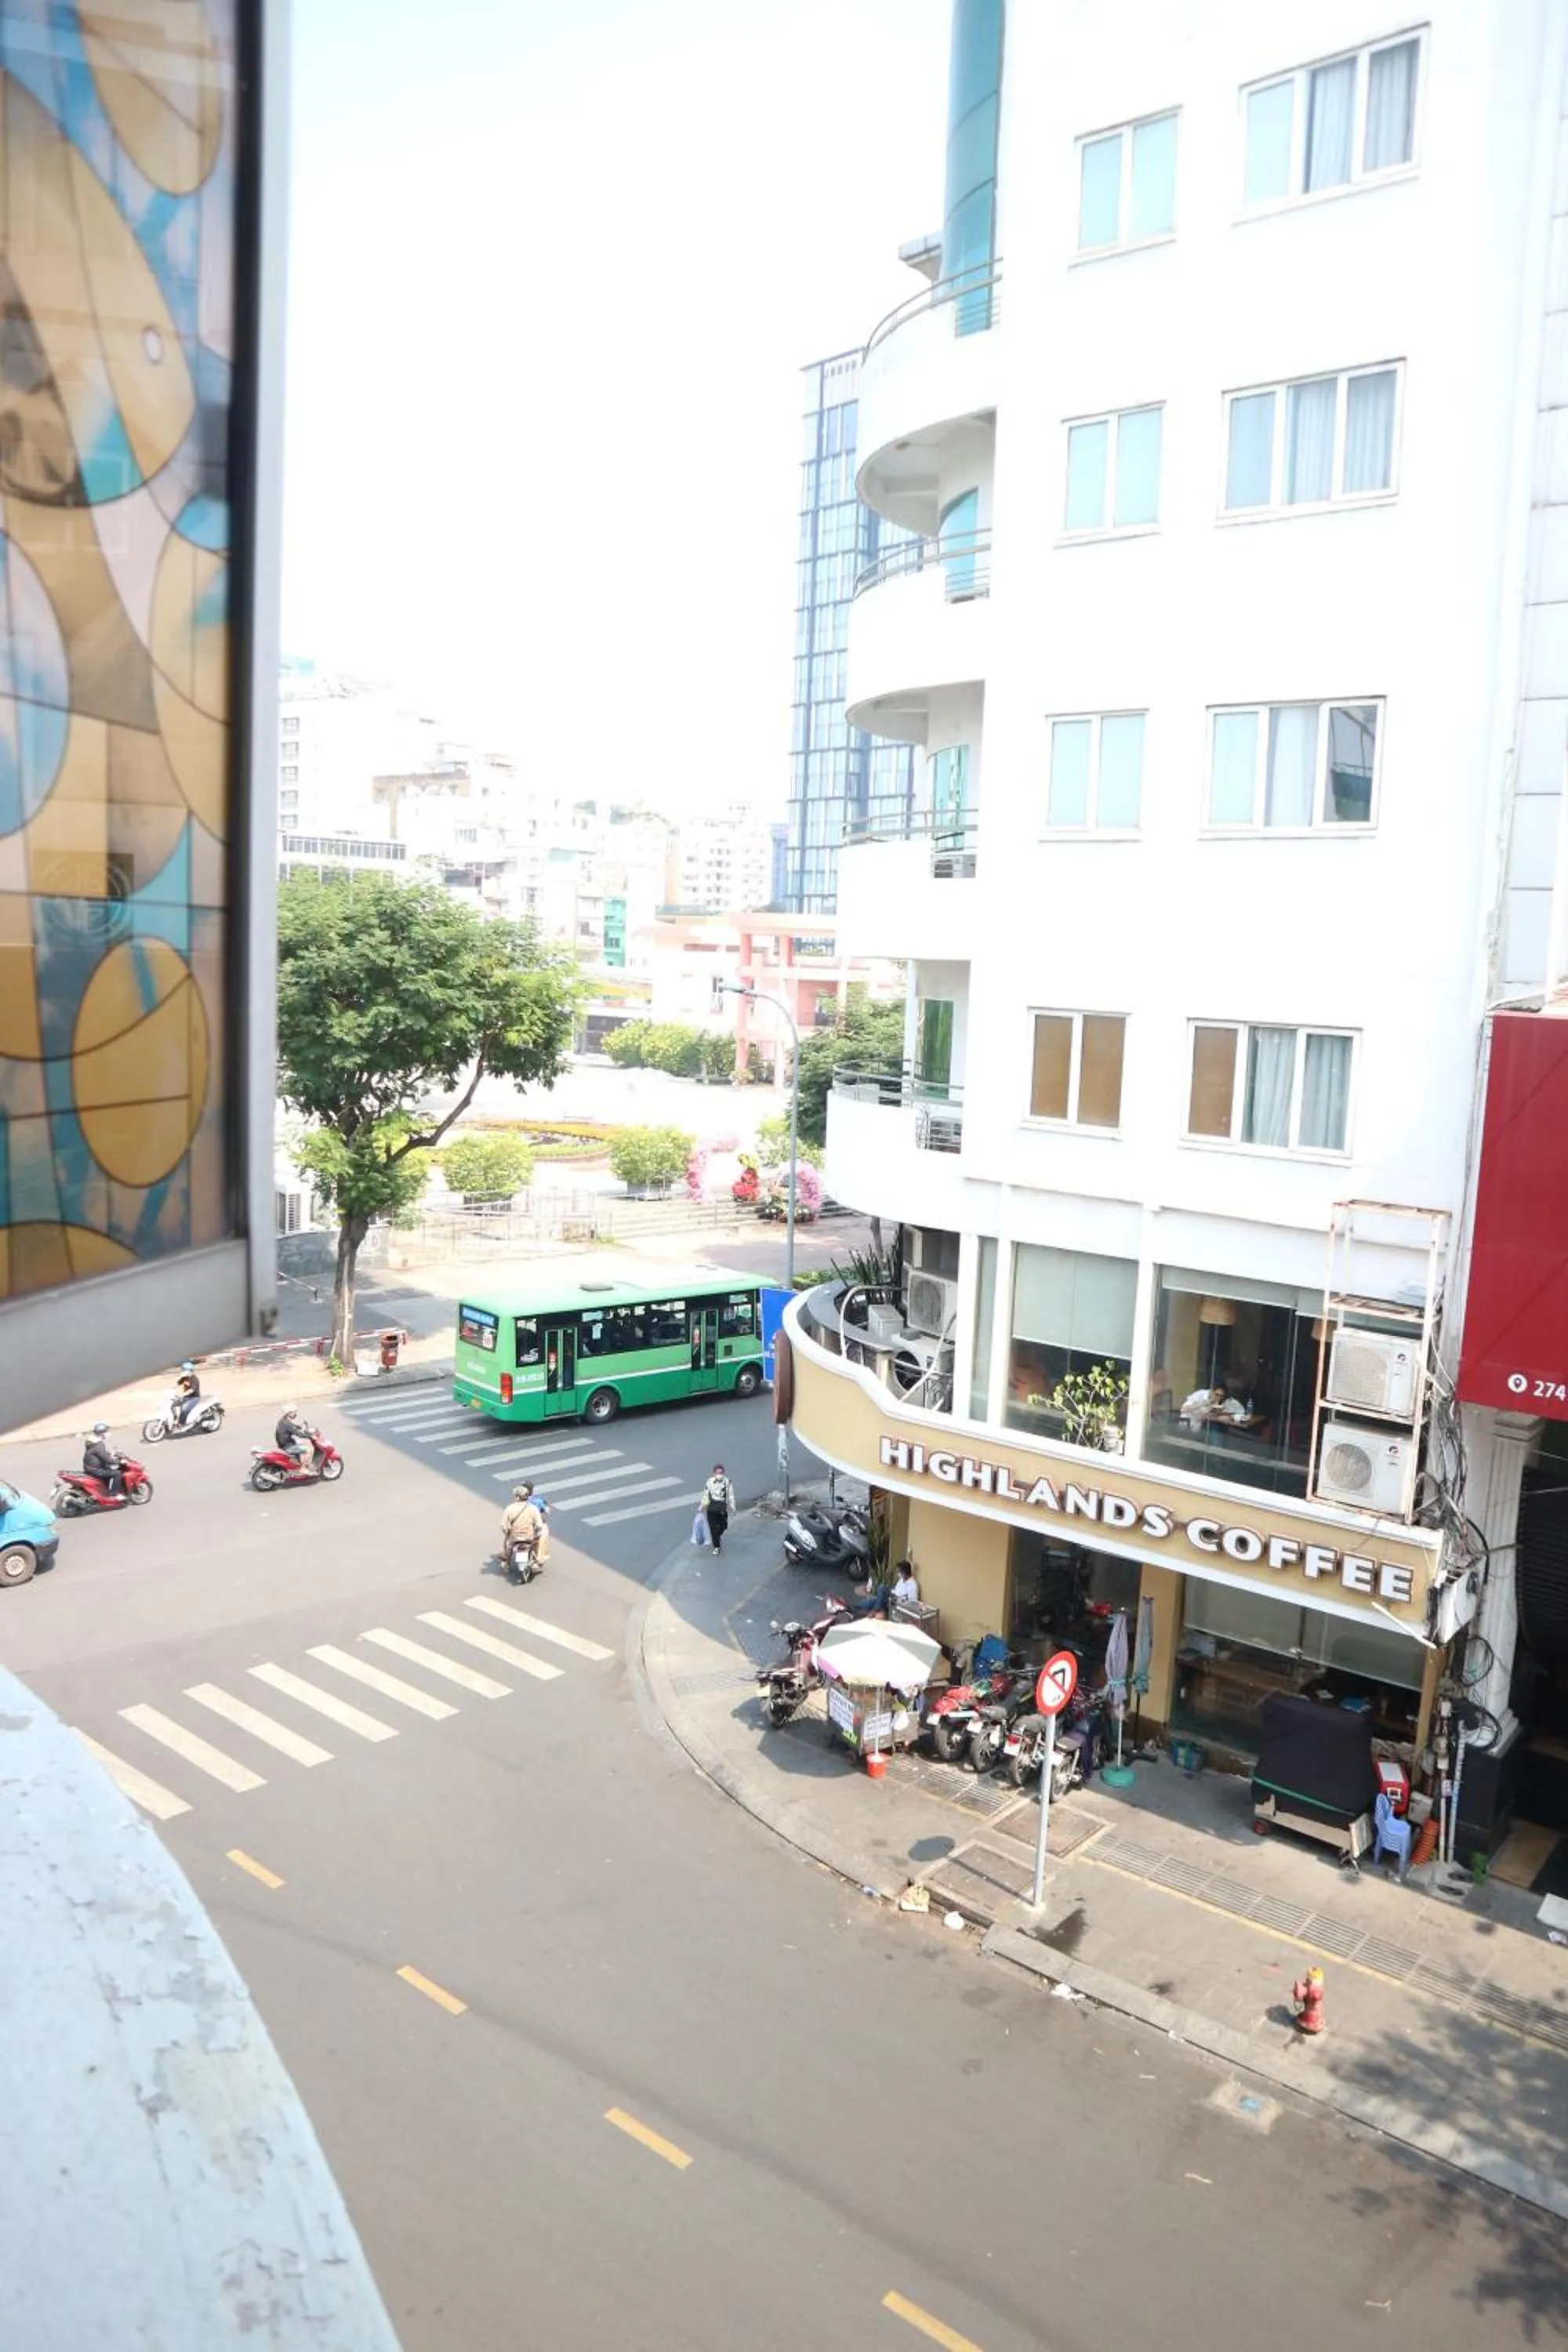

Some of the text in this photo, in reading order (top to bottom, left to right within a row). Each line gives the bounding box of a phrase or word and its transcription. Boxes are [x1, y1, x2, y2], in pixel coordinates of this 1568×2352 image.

[1534, 1380, 1566, 1401] 274
[879, 1437, 1414, 1603] HIGHLANDS COFFEE
